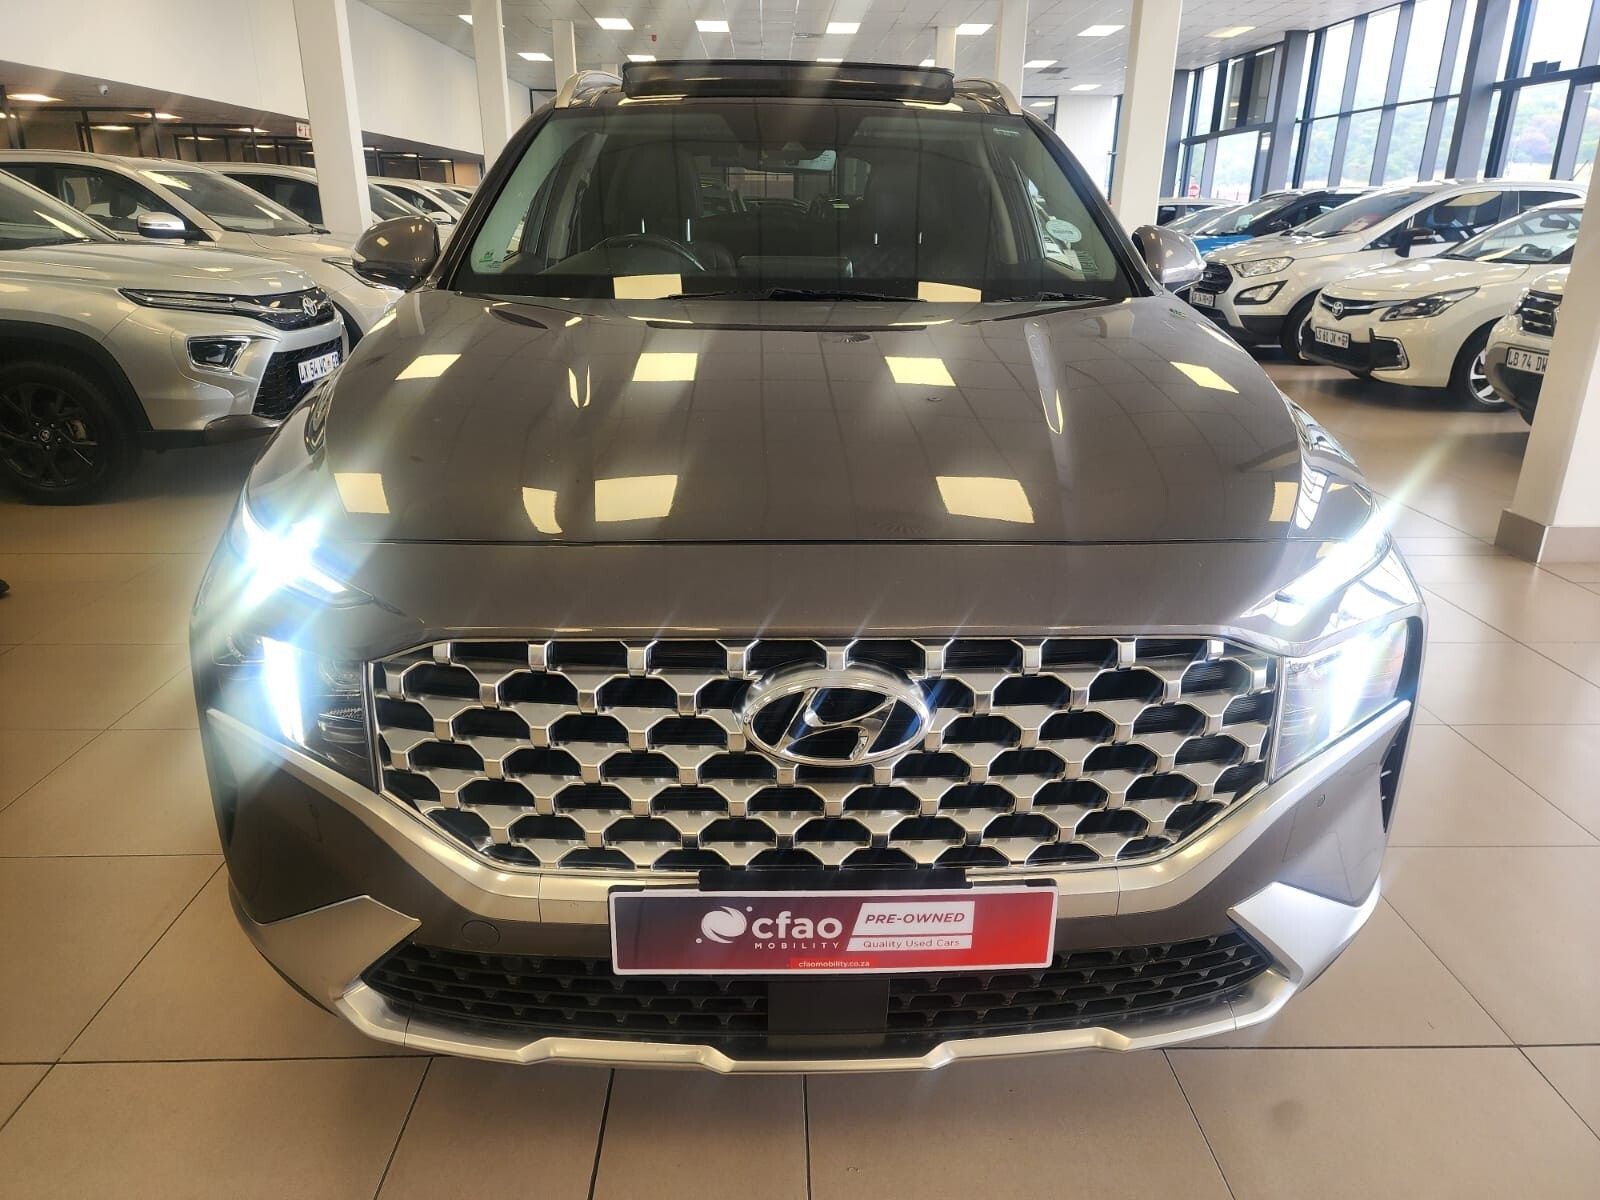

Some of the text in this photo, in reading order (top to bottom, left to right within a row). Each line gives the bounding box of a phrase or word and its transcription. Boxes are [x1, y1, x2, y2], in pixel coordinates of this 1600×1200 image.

[1508, 350, 1520, 367] LB
[1522, 353, 1532, 370] 74
[865, 912, 965, 925] PRE-OWNED
[751, 910, 843, 940] cfao
[754, 941, 840, 950] MOBILITY
[863, 938, 960, 950] Quality Used Cars
[798, 960, 870, 969] cfaomobility.co.za
